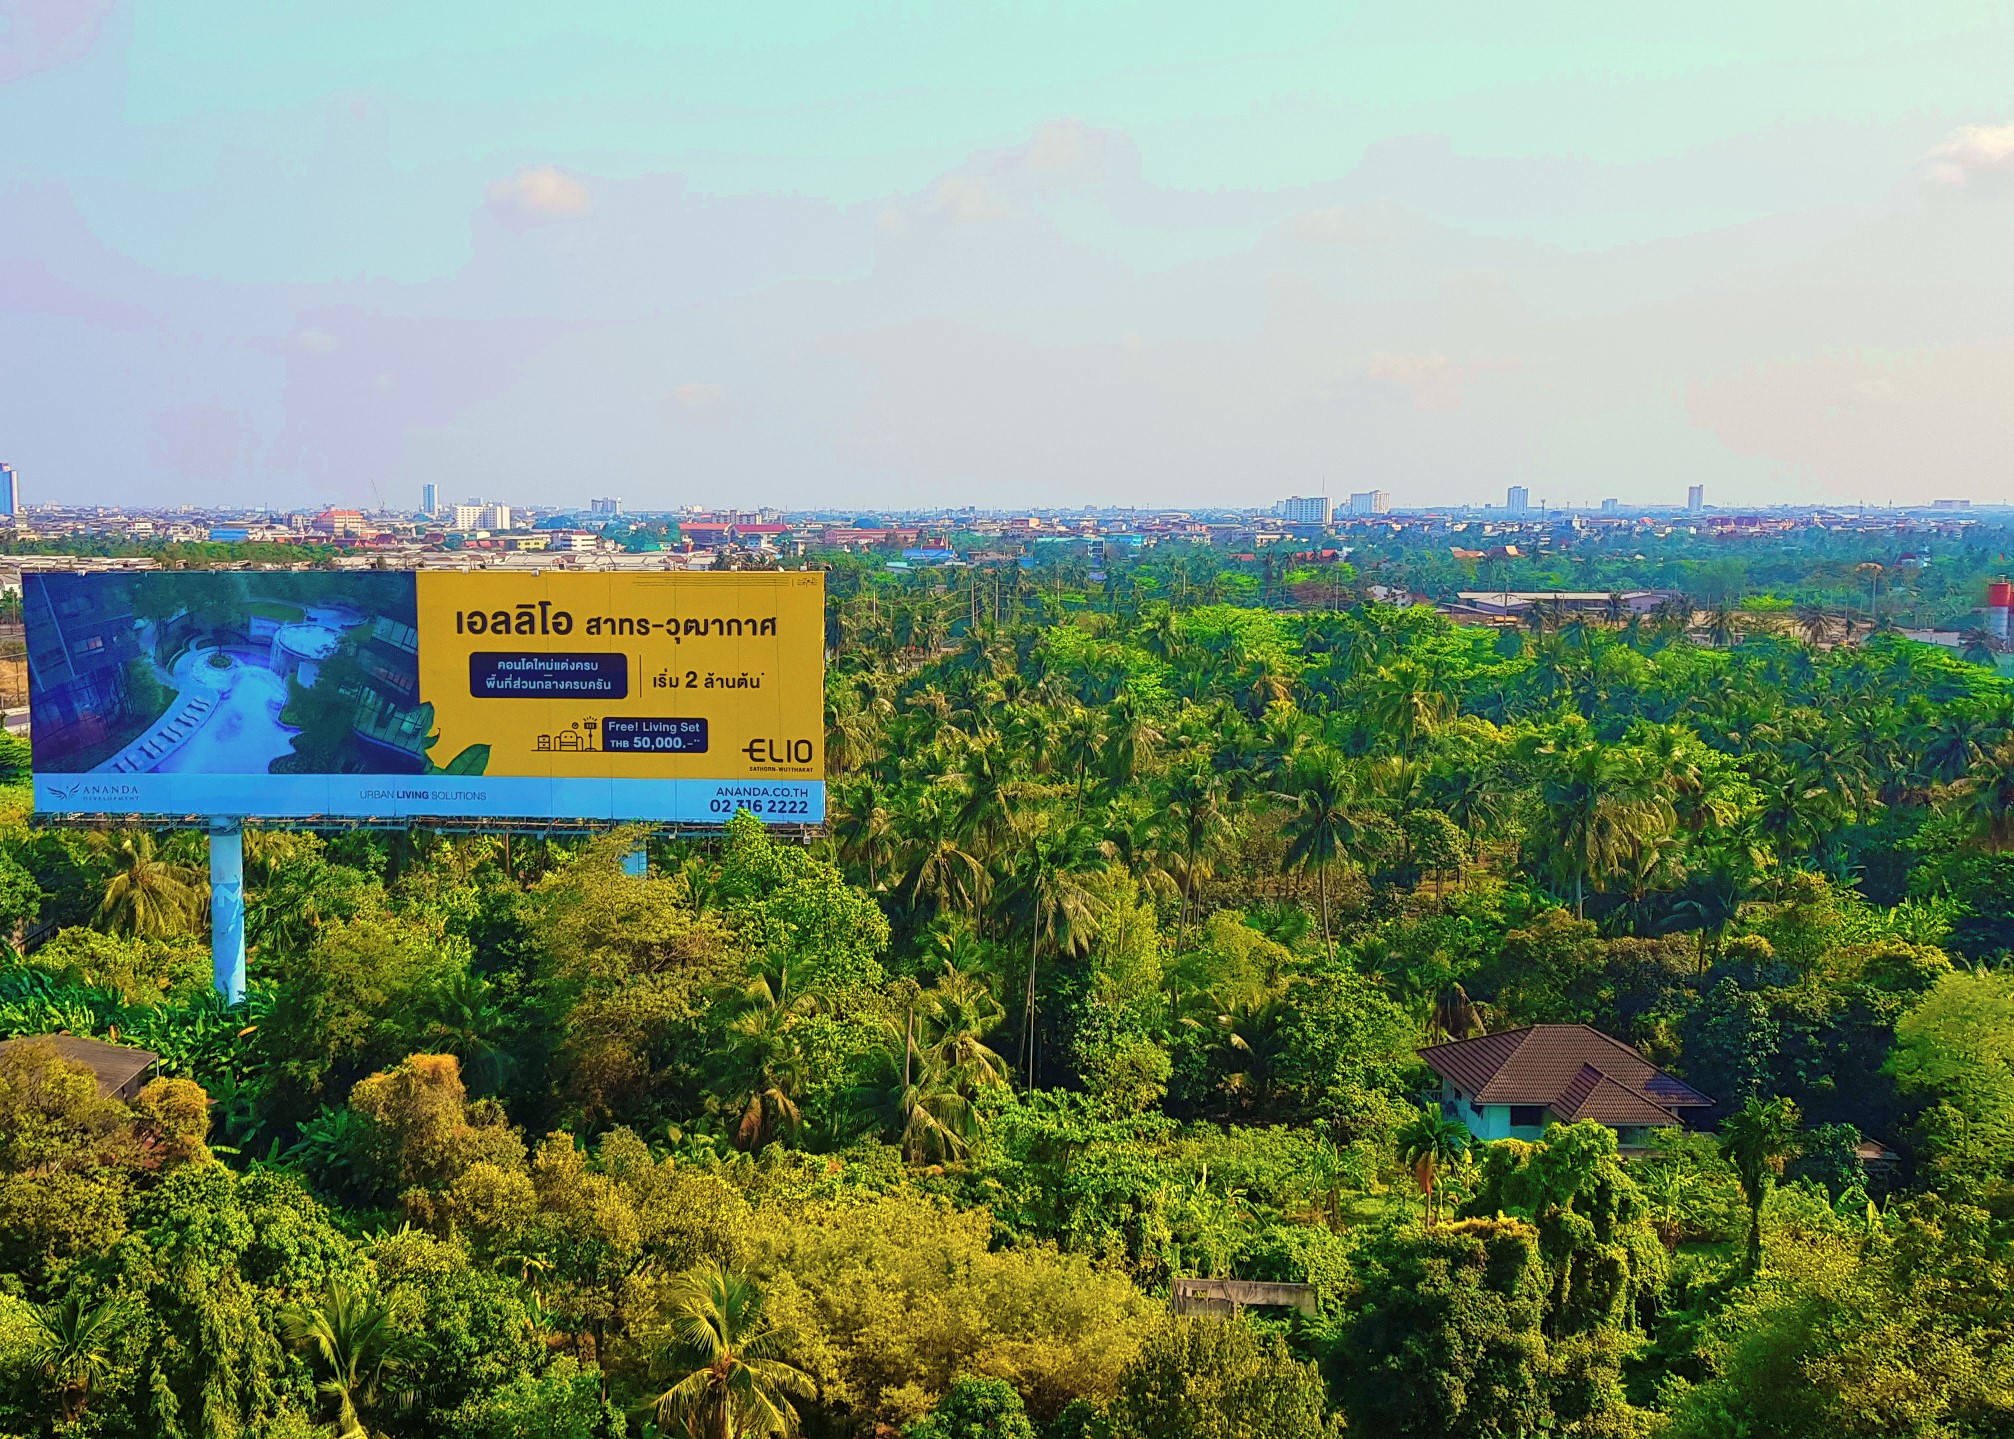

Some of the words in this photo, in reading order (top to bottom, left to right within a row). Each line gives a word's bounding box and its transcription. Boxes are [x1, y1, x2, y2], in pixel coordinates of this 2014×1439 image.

[456, 600, 573, 635] เอลลิโอ
[586, 616, 777, 645] สาทร-วุฒากาศ
[497, 658, 599, 671] คอนโดใหม่แต่งครบ
[485, 673, 612, 690] พื้นที่ส่วนกลางครบครัน
[653, 668, 679, 688] เริ่ม
[685, 671, 698, 688] 2
[608, 721, 639, 732] Free!
[642, 721, 677, 735] Living
[680, 722, 700, 732] Set
[610, 739, 630, 748] THB
[742, 738, 813, 763] ELIO
[83, 785, 139, 794] ANANDA
[360, 790, 394, 800] URBAN
[396, 790, 429, 800] LIVING
[431, 790, 487, 801] SOLUTIONS
[716, 787, 808, 798] ANANDA.CO.TH
[710, 799, 731, 813] 02
[767, 801, 808, 814] 2222
